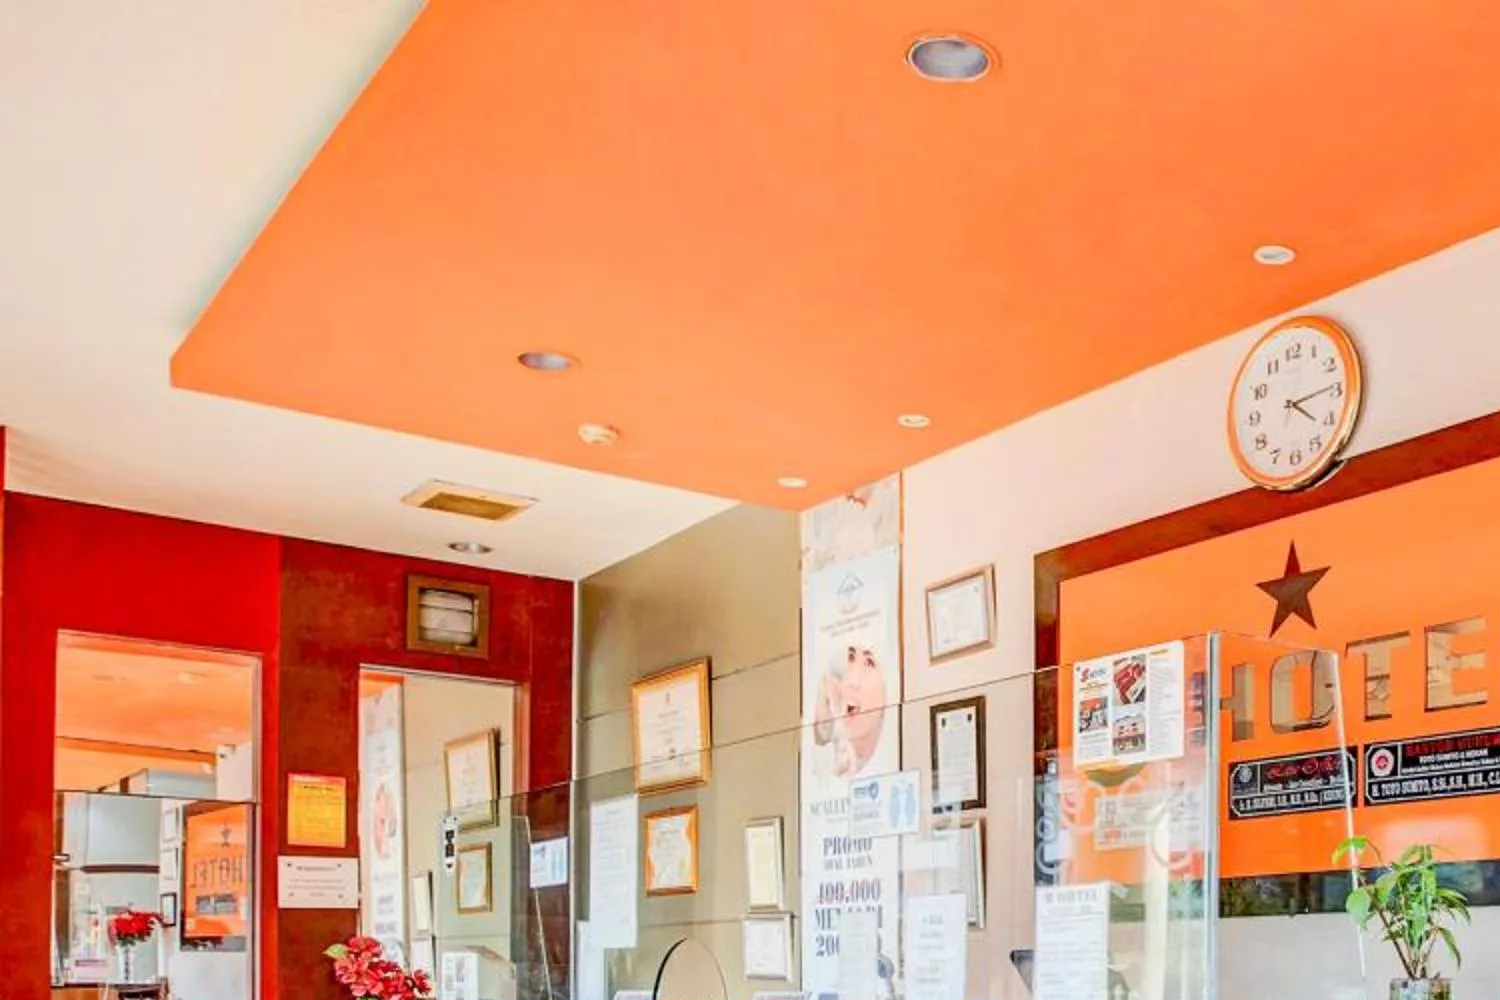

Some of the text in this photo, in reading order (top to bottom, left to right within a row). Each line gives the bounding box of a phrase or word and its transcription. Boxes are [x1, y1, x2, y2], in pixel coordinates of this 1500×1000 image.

[1285, 343, 1302, 362] 12
[1310, 345, 1317, 359] 1
[1266, 359, 1279, 375] 11
[1322, 356, 1336, 373] 2
[1252, 383, 1268, 401] 10
[1330, 382, 1343, 398] 3
[1247, 410, 1261, 427] 9
[1323, 410, 1335, 426] 4
[1255, 433, 1268, 450] 8
[1309, 435, 1322, 453] 5
[1270, 447, 1281, 465] 7
[1289, 449, 1302, 466] 6
[823, 836, 873, 857] PROMO
